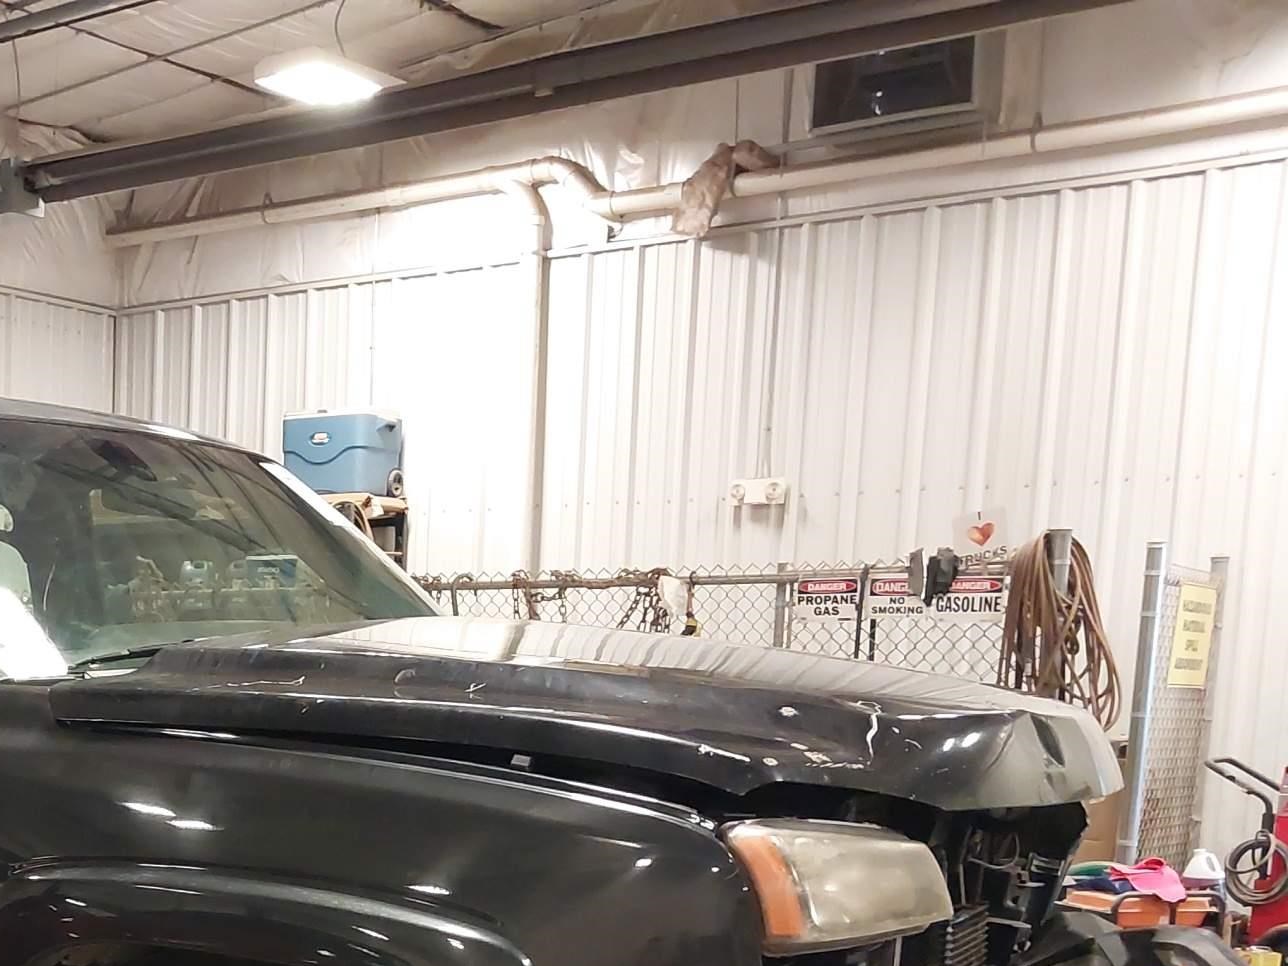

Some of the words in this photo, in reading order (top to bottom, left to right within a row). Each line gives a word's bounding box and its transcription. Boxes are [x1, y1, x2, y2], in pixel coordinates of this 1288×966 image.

[807, 582, 847, 592] DANGER
[876, 582, 909, 592] DANG
[798, 595, 857, 605] PROPANE
[889, 597, 905, 605] NO
[936, 596, 1002, 612] GASOLINE
[814, 606, 840, 616] GAS
[872, 606, 923, 615] SMOKING
